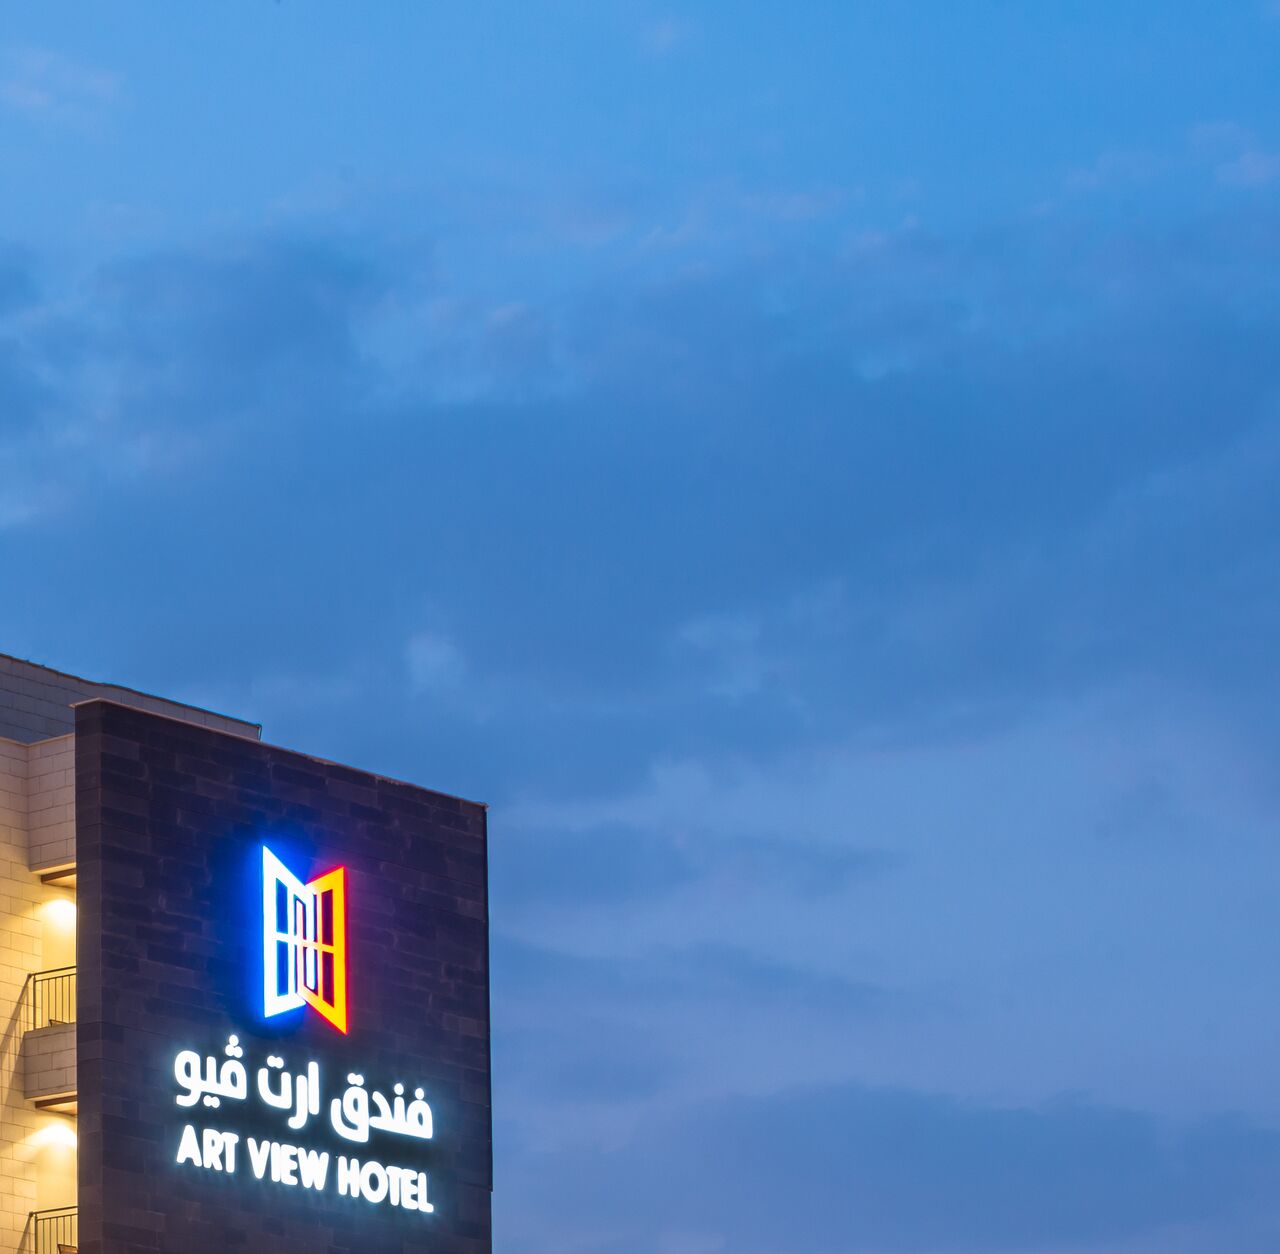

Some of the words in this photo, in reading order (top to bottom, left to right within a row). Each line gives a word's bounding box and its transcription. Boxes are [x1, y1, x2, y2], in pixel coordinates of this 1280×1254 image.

[257, 1055, 319, 1129] ارت
[330, 1072, 434, 1142] فندق
[176, 1125, 239, 1173] ART
[247, 1137, 329, 1190] VIEW
[338, 1156, 434, 1213] HOTEL
